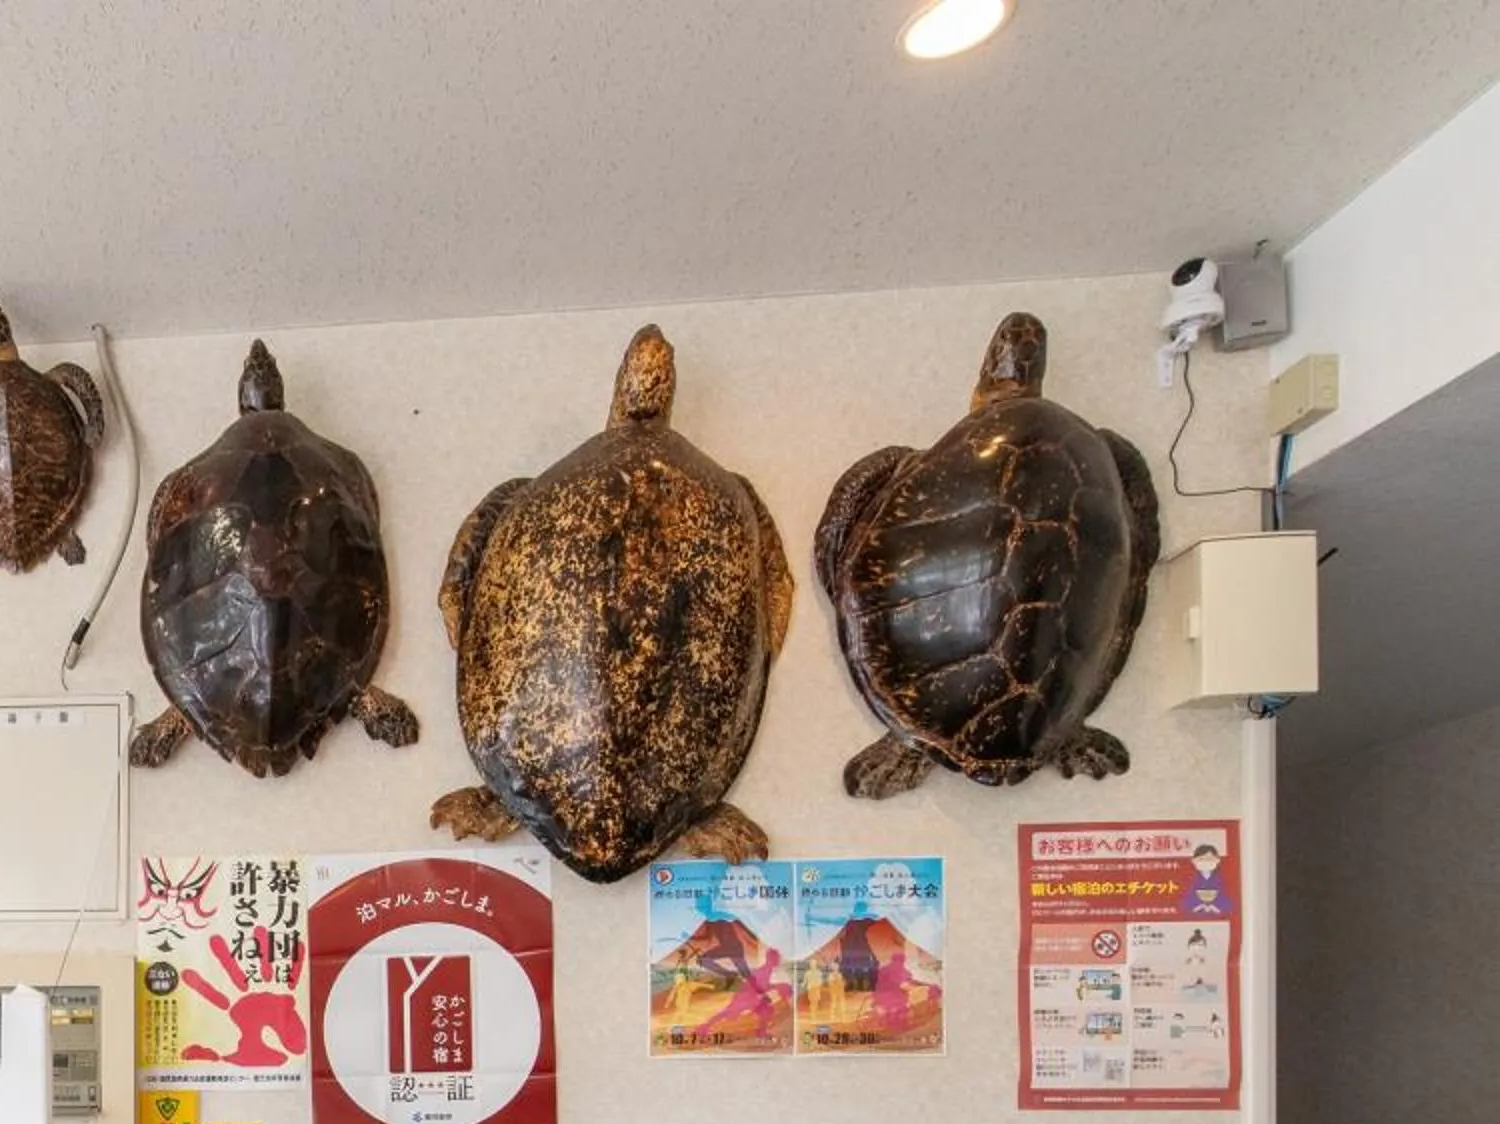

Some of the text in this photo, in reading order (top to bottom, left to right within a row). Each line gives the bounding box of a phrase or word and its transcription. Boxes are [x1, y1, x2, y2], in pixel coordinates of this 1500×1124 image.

[1038, 834, 1192, 855] お客様へのお願い
[230, 861, 263, 984] 許さねえ
[268, 860, 300, 984] 暴力団は
[356, 887, 494, 924] 泊マル、かごしま。
[432, 995, 448, 1064] 安心の宿
[450, 996, 465, 1063] かごしま
